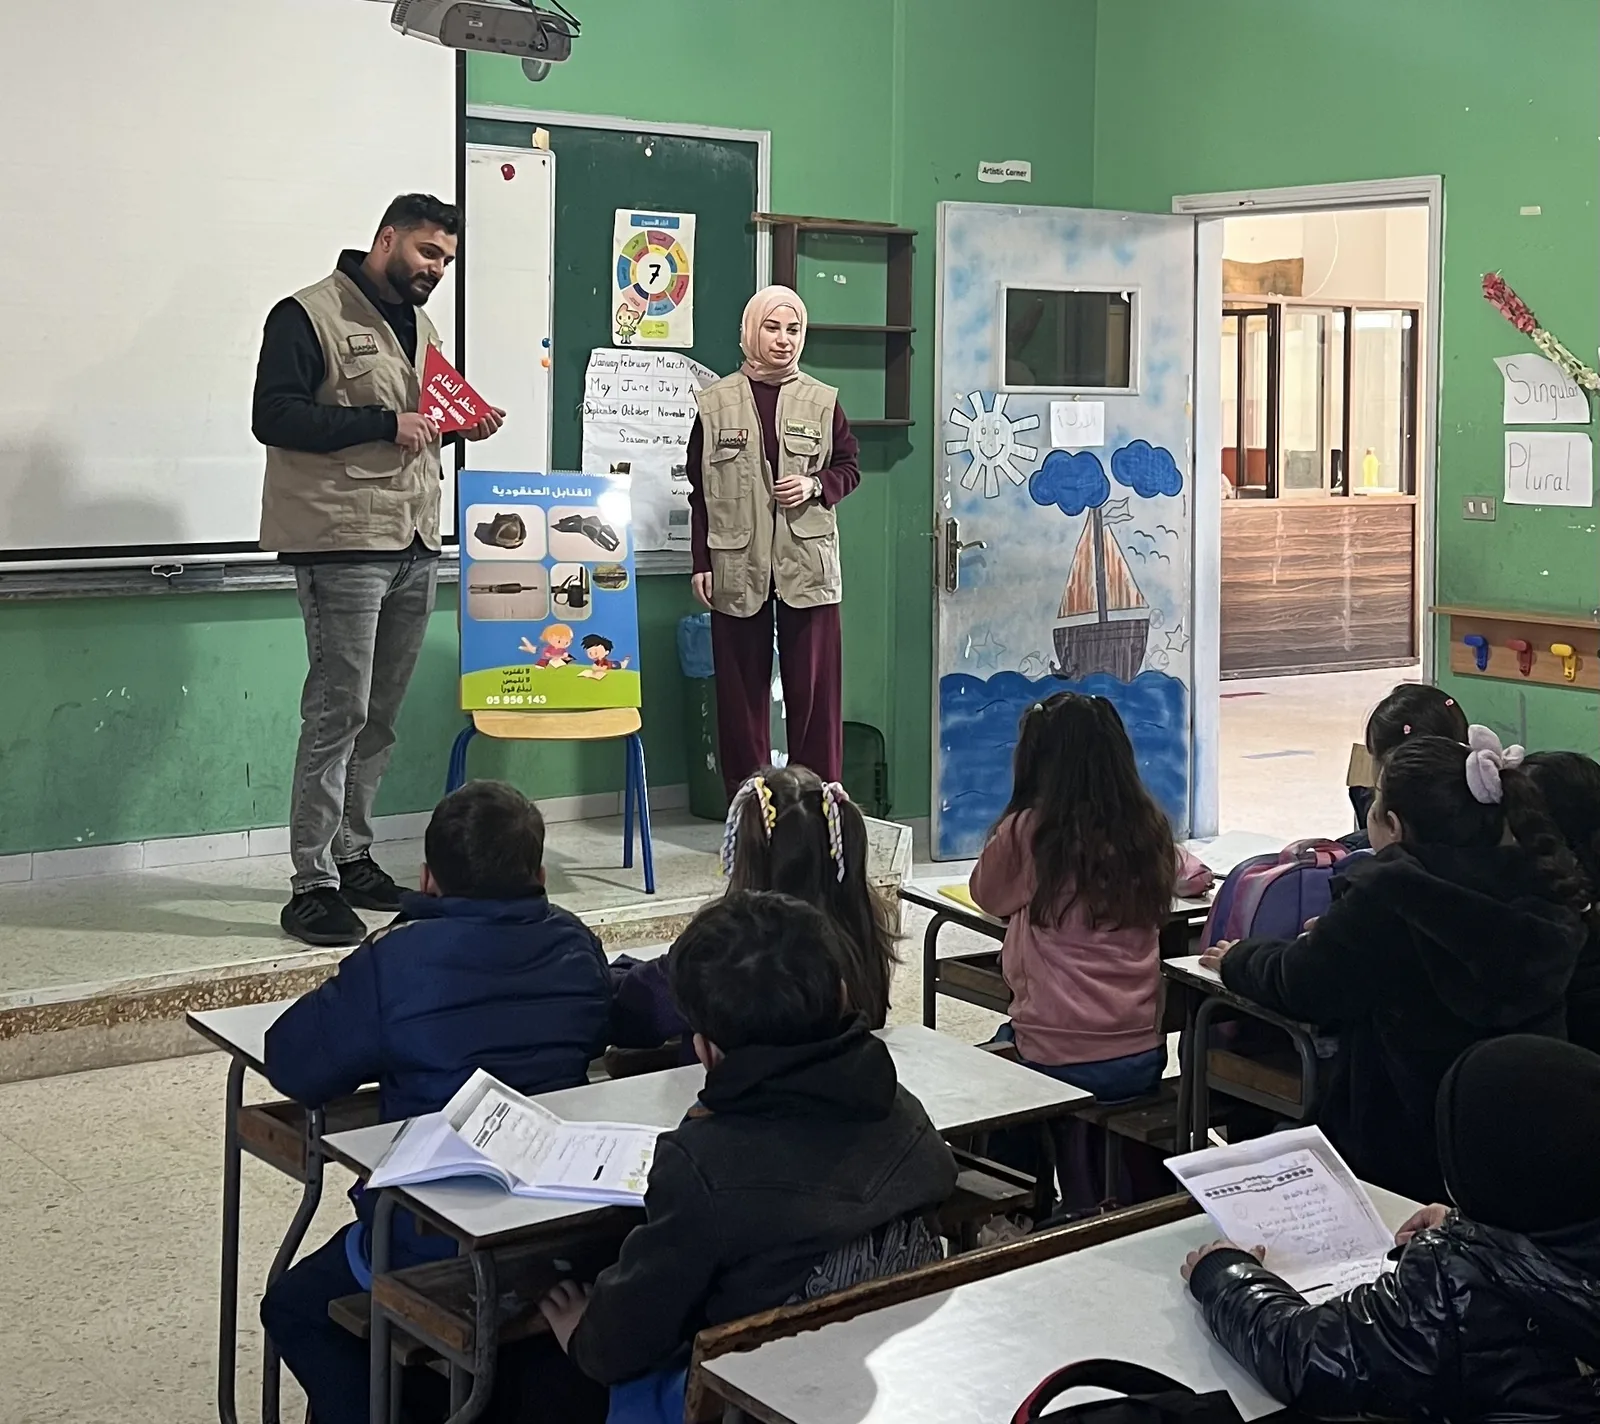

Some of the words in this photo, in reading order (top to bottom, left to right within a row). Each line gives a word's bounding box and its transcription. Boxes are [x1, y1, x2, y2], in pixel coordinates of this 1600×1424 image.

[982, 166, 1004, 176] Artistic
[1005, 168, 1027, 177] Corner
[649, 264, 661, 285] 7
[656, 357, 685, 369] March
[431, 373, 464, 397] ألغام
[591, 378, 611, 397] May
[621, 379, 649, 392] June
[658, 380, 679, 397] July
[1505, 363, 1578, 421] Singular
[426, 383, 450, 409] DANGER
[446, 405, 467, 426] MINES
[453, 396, 477, 416] خطر
[621, 404, 650, 416] October
[619, 429, 649, 444] Seasons
[1508, 441, 1570, 491] Plural
[492, 485, 551, 498] العنقودية
[551, 486, 592, 499] القنابل
[486, 695, 500, 705] 05
[502, 695, 524, 705] 956
[526, 695, 547, 705] 143
